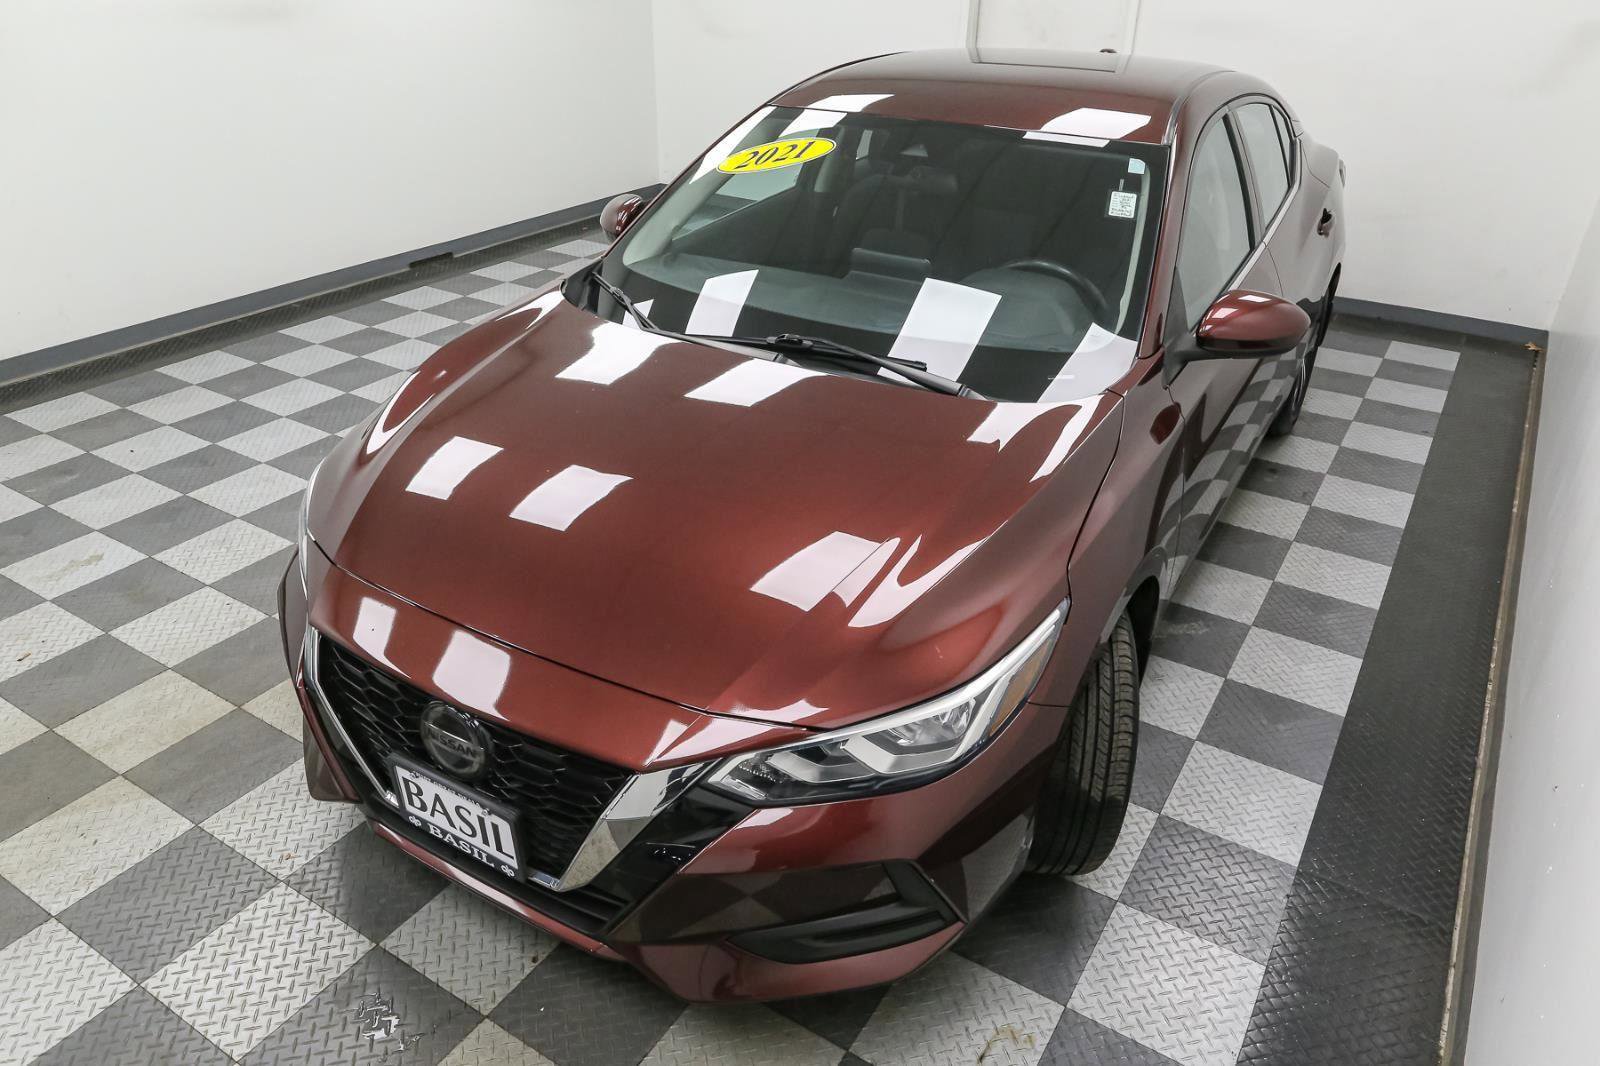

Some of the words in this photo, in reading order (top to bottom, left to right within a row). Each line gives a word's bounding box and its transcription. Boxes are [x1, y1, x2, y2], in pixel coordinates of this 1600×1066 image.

[733, 140, 816, 170] 2021
[426, 727, 477, 757] NISSAN
[402, 776, 514, 860] BASIL
[427, 822, 495, 867] BASIL
